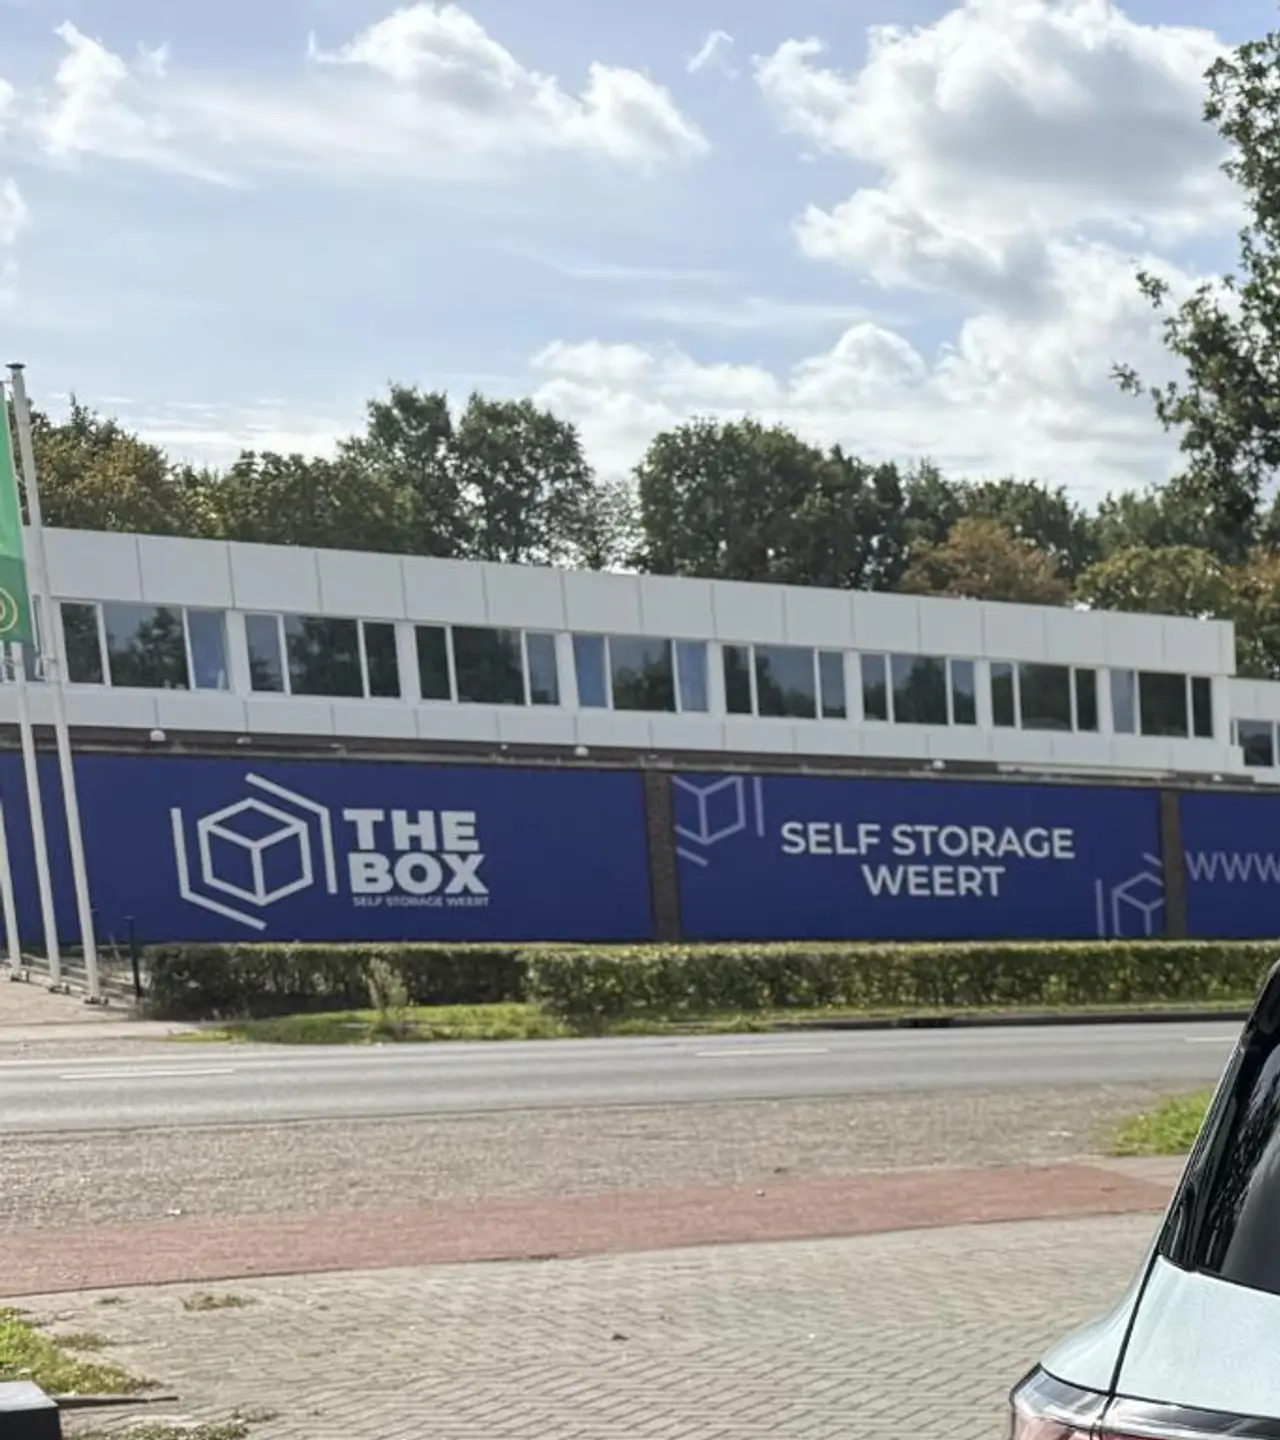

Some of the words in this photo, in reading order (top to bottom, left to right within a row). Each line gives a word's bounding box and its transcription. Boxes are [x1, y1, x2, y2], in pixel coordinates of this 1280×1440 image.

[342, 808, 479, 851] THE
[781, 822, 881, 855] SELF
[891, 824, 1076, 859] STORAGE
[348, 852, 489, 895] BOX
[861, 864, 1006, 897] WEERT
